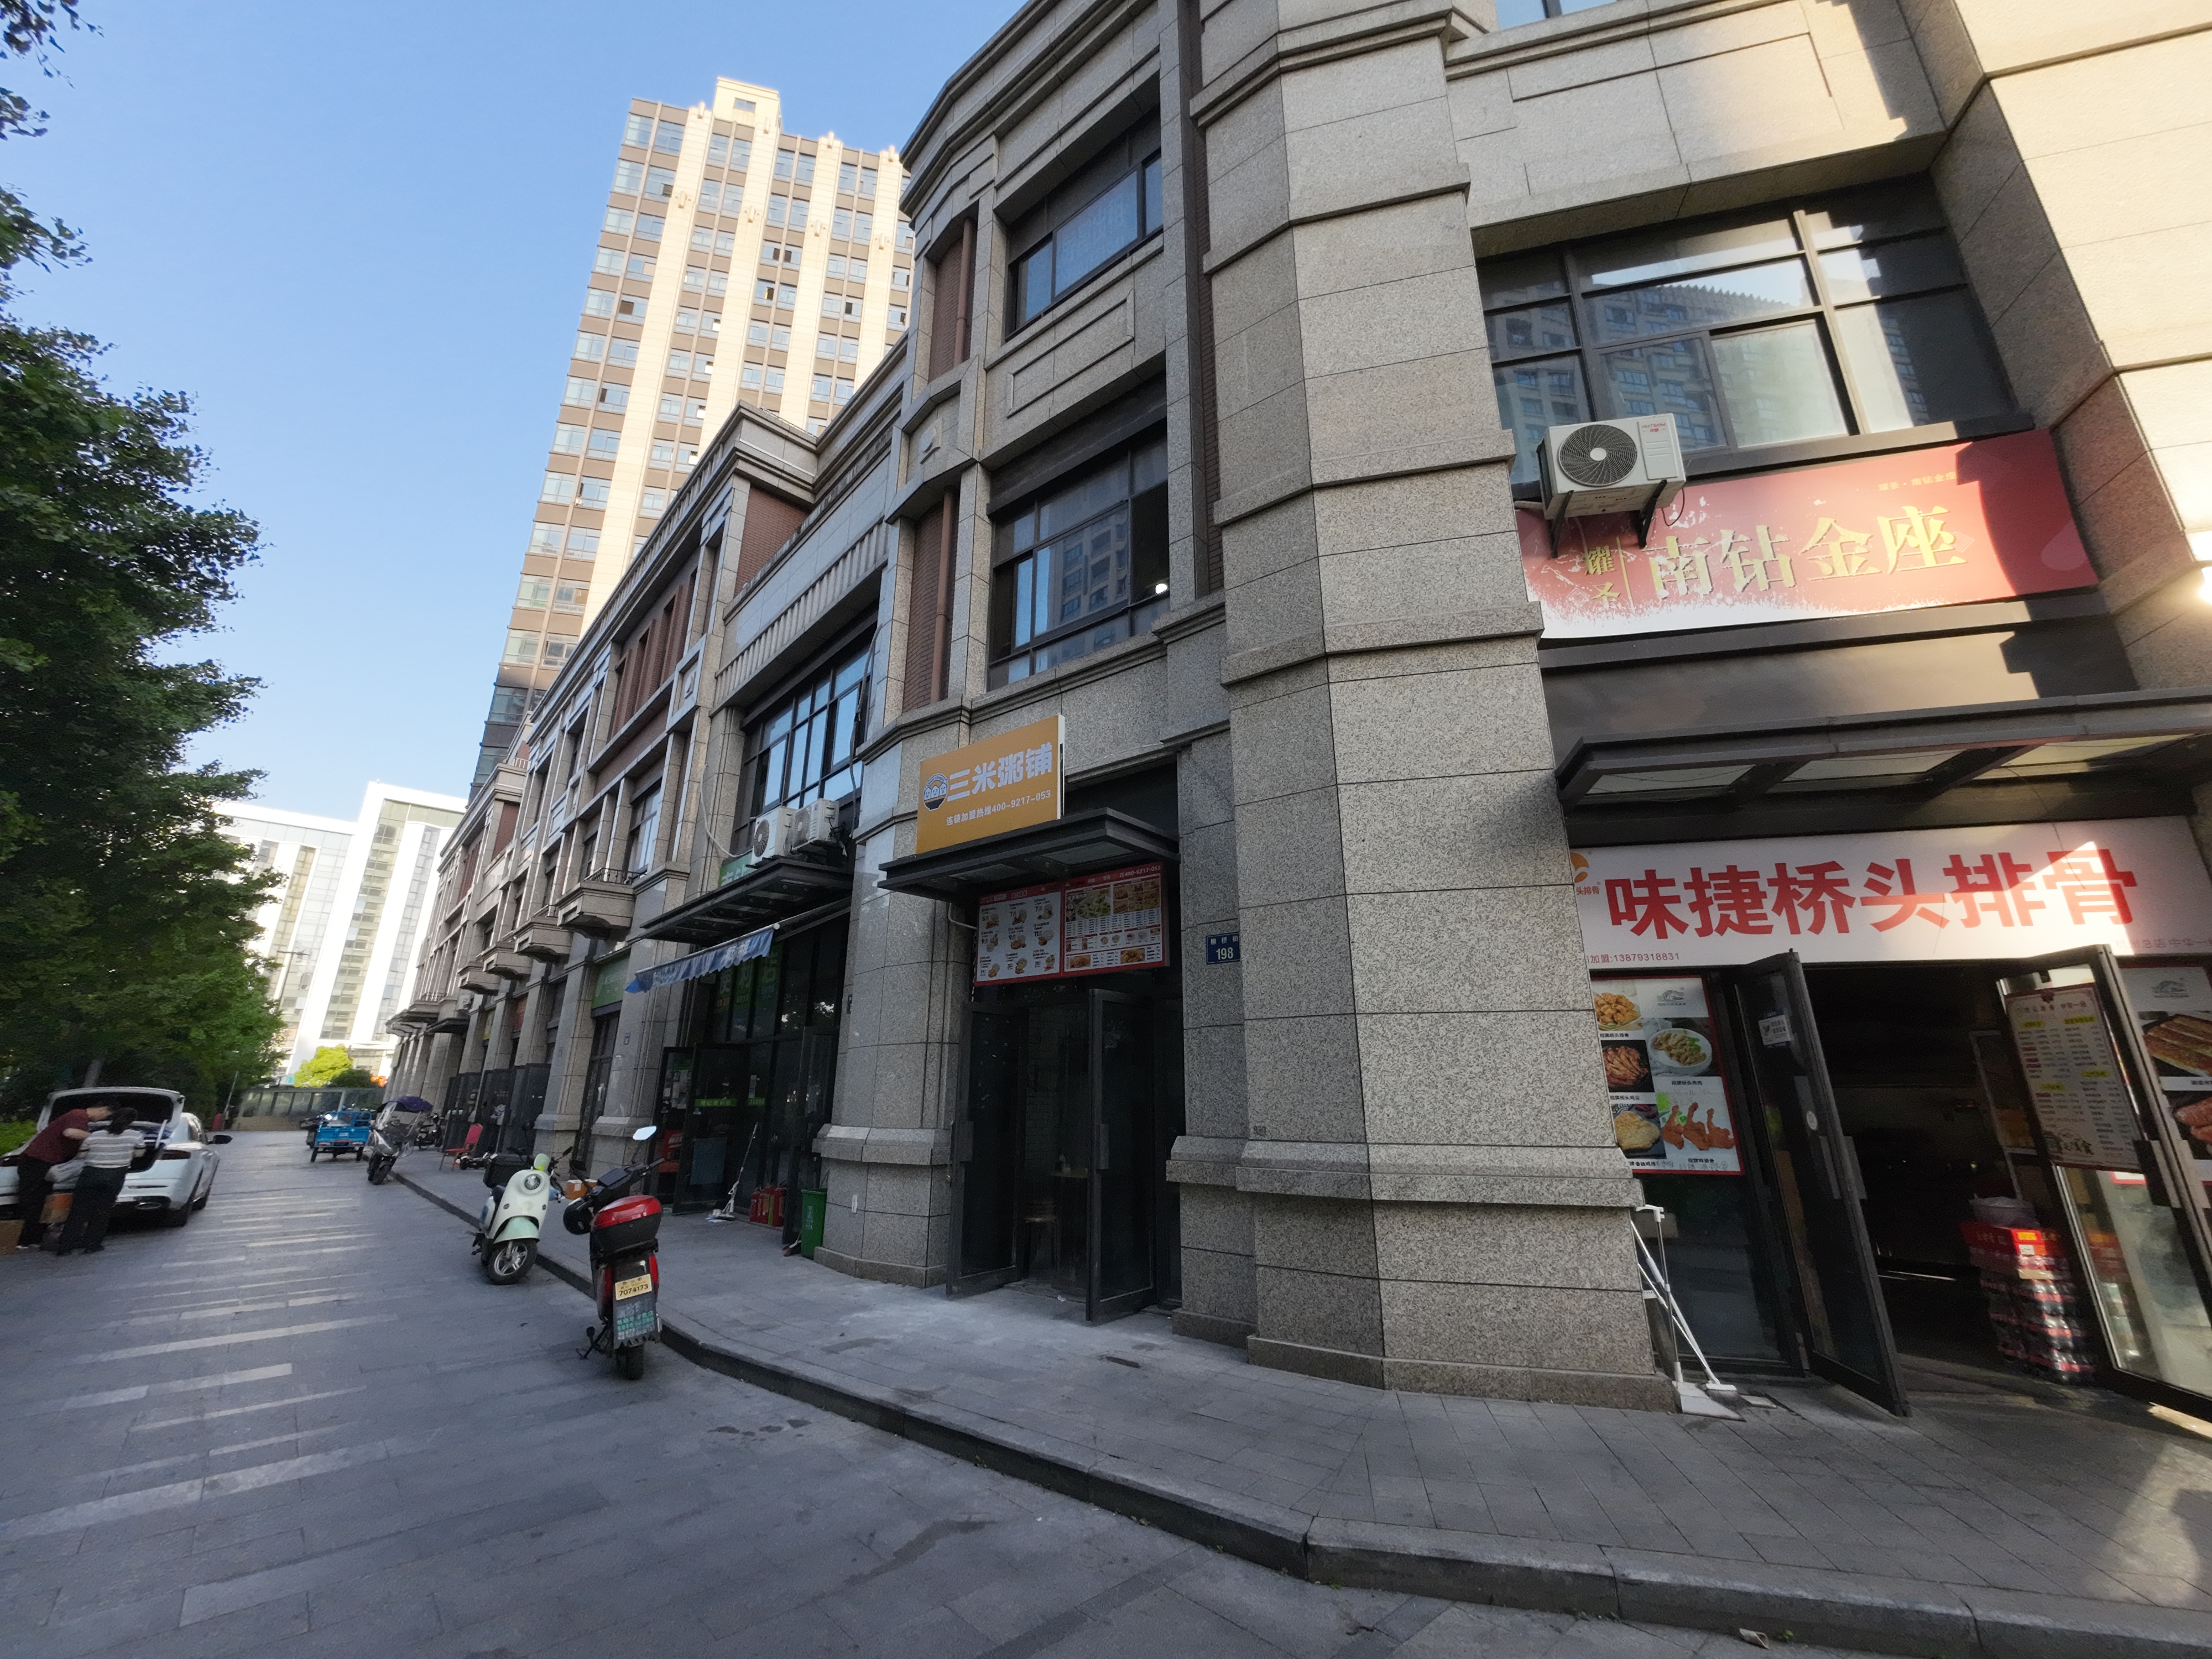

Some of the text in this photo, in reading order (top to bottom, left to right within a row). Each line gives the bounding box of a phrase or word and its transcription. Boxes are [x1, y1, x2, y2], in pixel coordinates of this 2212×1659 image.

[1643, 505, 1969, 600] 南钻金座
[947, 742, 1052, 802] 三米粥铺
[1605, 848, 2138, 940] 味捷桥头排骨
[1215, 947, 1234, 960] 198
